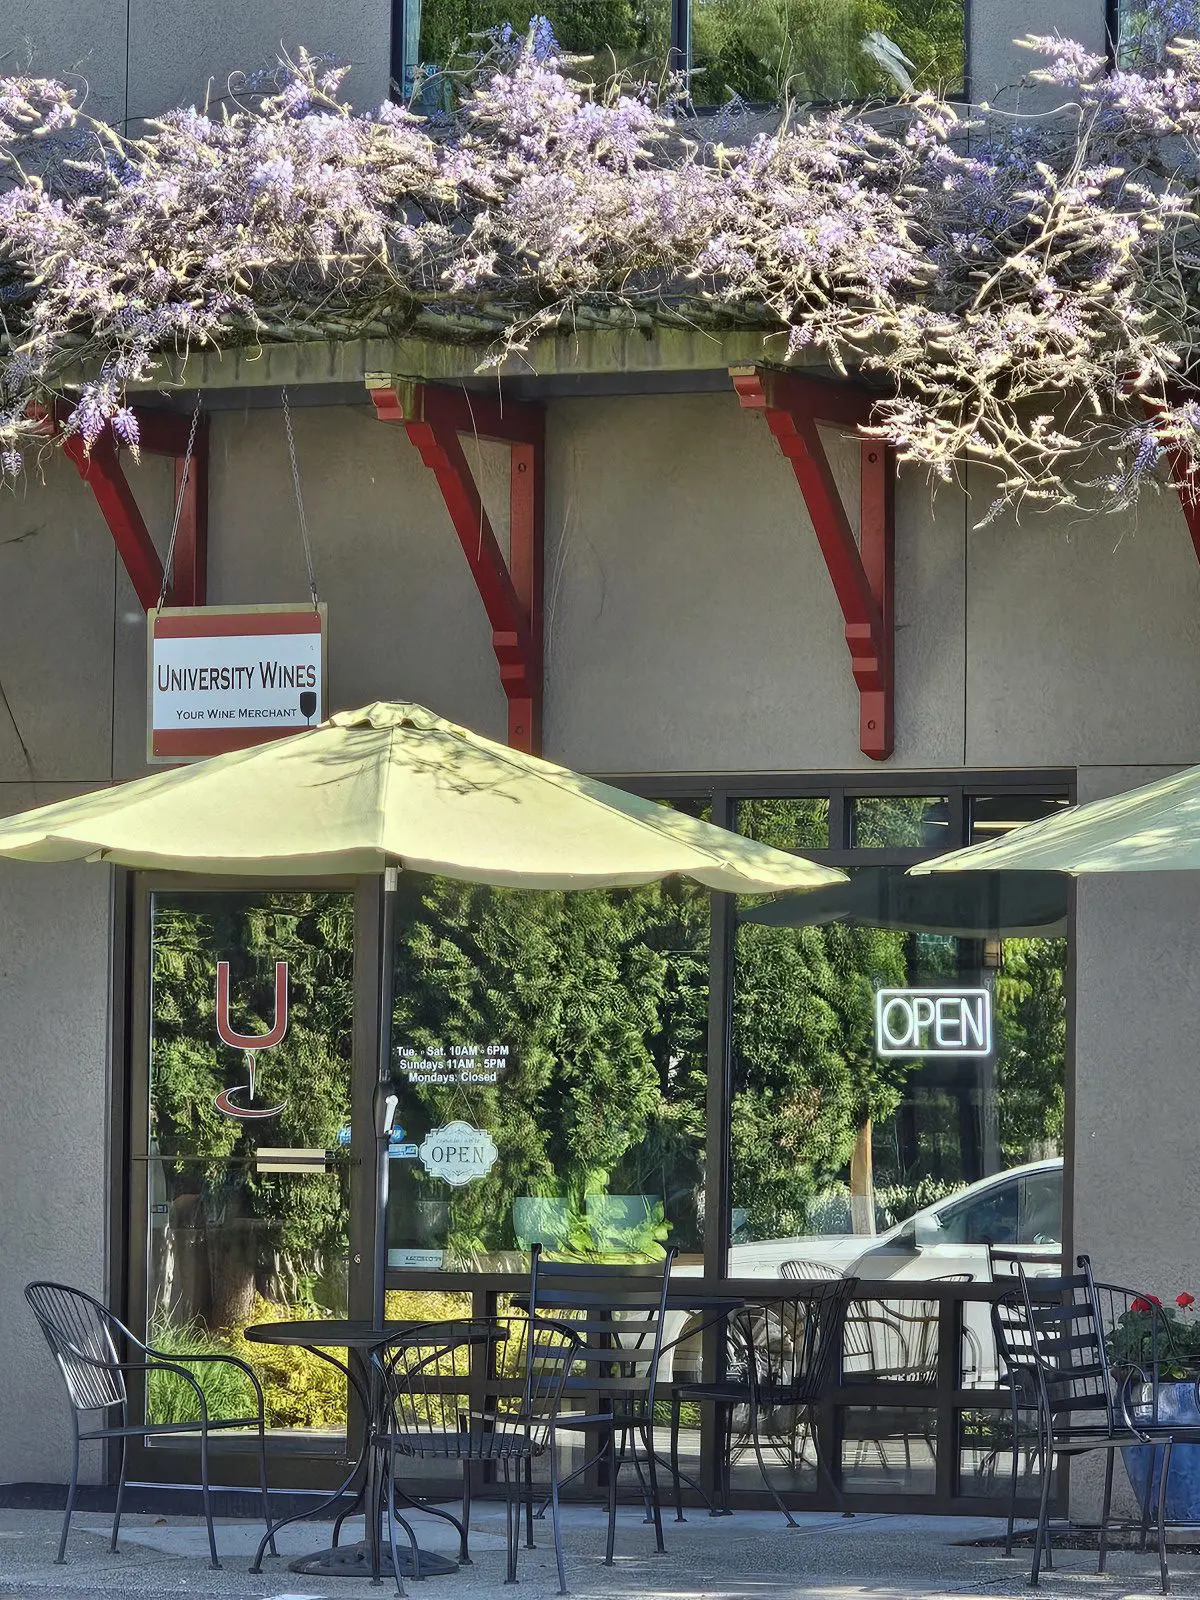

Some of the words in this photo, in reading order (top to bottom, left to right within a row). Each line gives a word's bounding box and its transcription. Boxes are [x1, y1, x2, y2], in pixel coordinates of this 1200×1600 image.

[158, 664, 255, 692] UNIVERSITY
[259, 661, 317, 689] WINES
[176, 710, 204, 720] YOUR
[207, 709, 236, 719] WINE
[238, 708, 297, 719] MERCHANT
[882, 997, 984, 1046] OPEN
[397, 1046, 417, 1056] Tue.
[426, 1046, 446, 1056] Sat.
[450, 1045, 478, 1056] 10AM
[487, 1045, 509, 1056] 6PM
[400, 1059, 444, 1072] Sundays
[446, 1059, 475, 1069] 11AM
[484, 1059, 506, 1069] 5PM
[461, 1072, 497, 1082] Closed
[431, 1146, 485, 1164] OPEN
